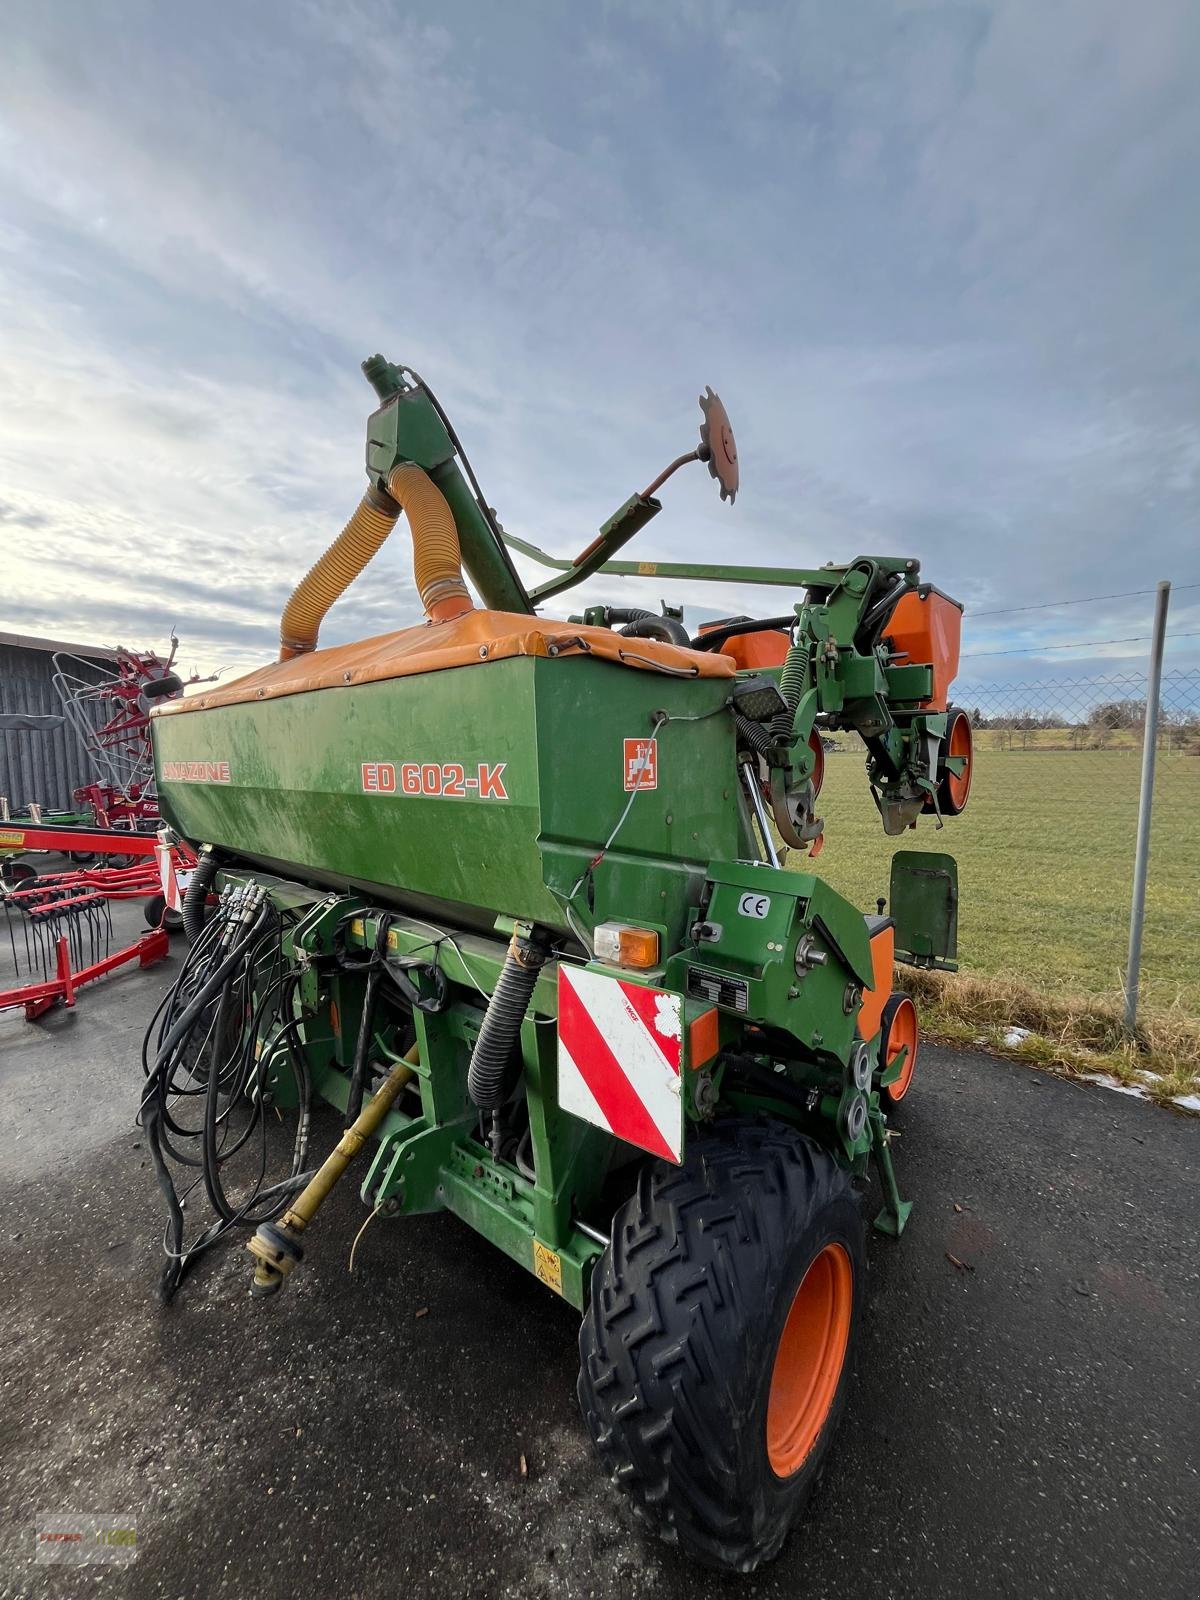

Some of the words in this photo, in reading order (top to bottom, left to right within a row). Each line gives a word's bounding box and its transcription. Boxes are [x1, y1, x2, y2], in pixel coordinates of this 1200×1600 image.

[162, 761, 230, 783] AMAZONE
[361, 762, 396, 793] ED
[401, 763, 509, 800] 602-K
[626, 780, 656, 788] AMZONE
[742, 896, 767, 916] CE
